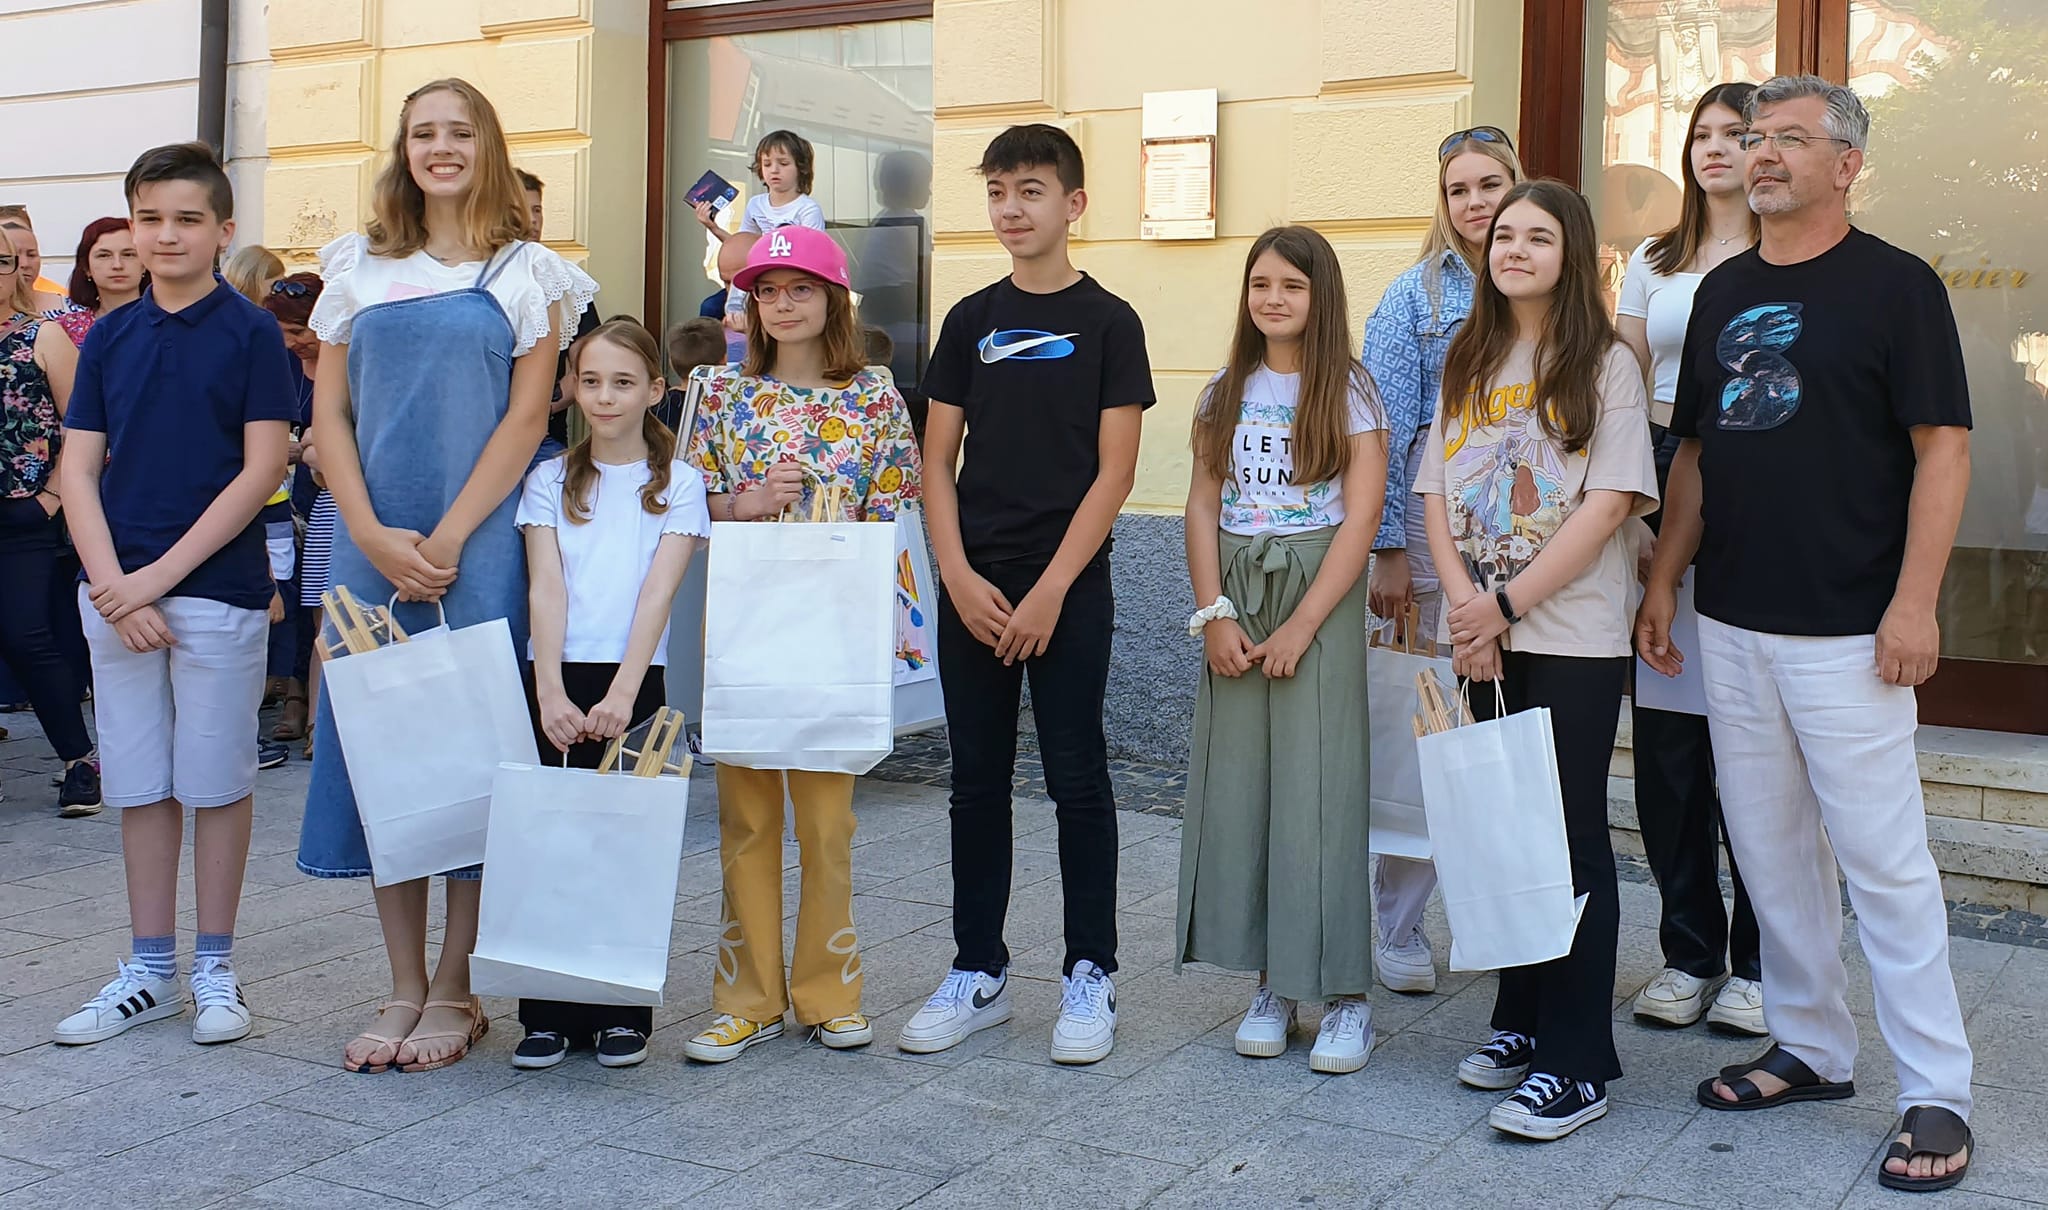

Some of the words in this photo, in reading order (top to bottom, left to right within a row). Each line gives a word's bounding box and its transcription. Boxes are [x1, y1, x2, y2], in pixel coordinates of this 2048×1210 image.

[768, 231, 792, 258] LA
[1243, 434, 1292, 455] LET
[1242, 467, 1294, 486] SUN
